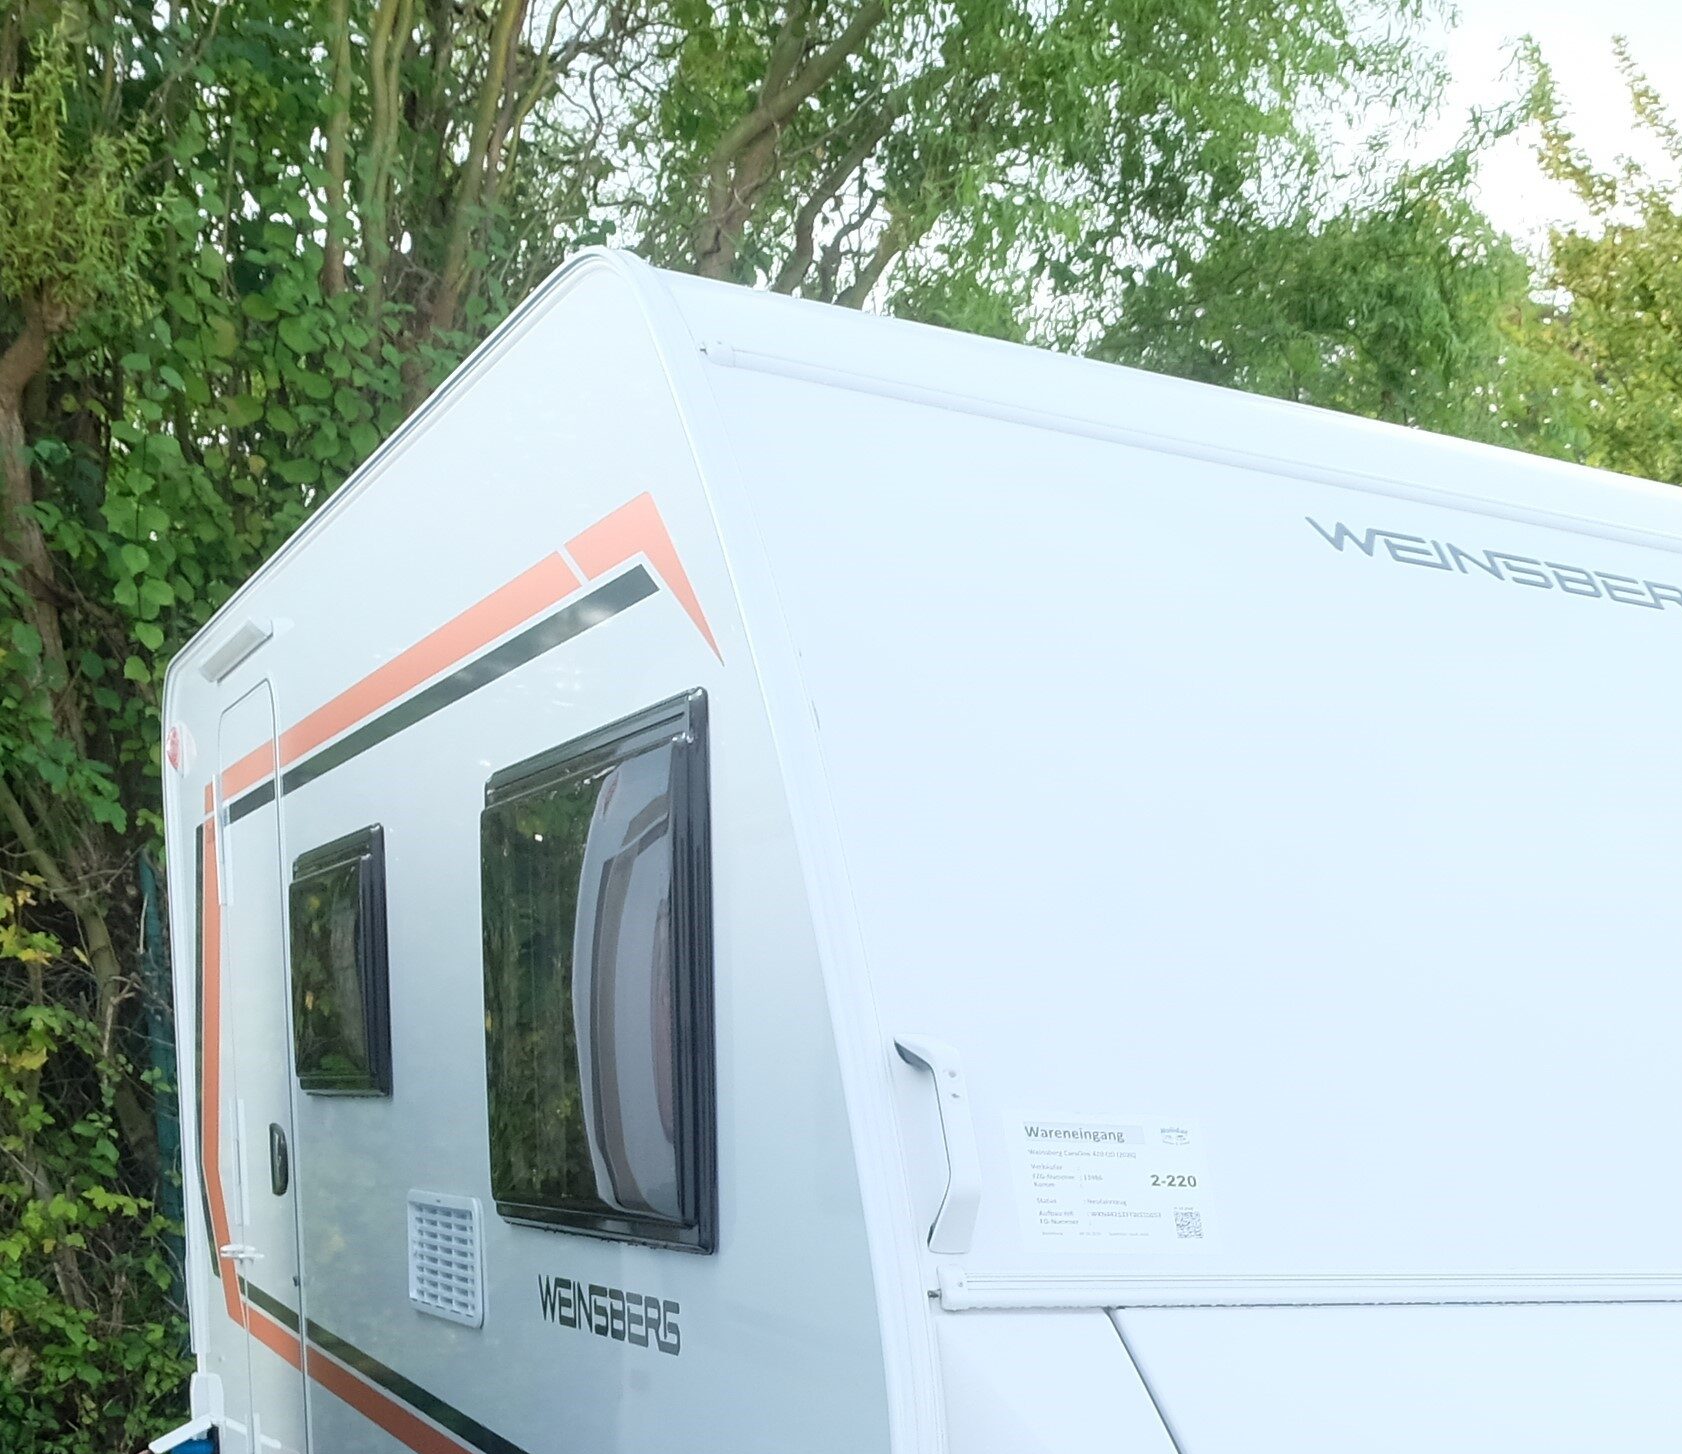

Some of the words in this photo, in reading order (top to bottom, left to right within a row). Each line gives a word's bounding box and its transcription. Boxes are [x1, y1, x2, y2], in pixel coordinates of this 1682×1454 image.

[1024, 1125, 1125, 1143] Wareneingang
[1150, 1174, 1197, 1188] 2-220
[538, 1274, 681, 1356] WEINSBERG
